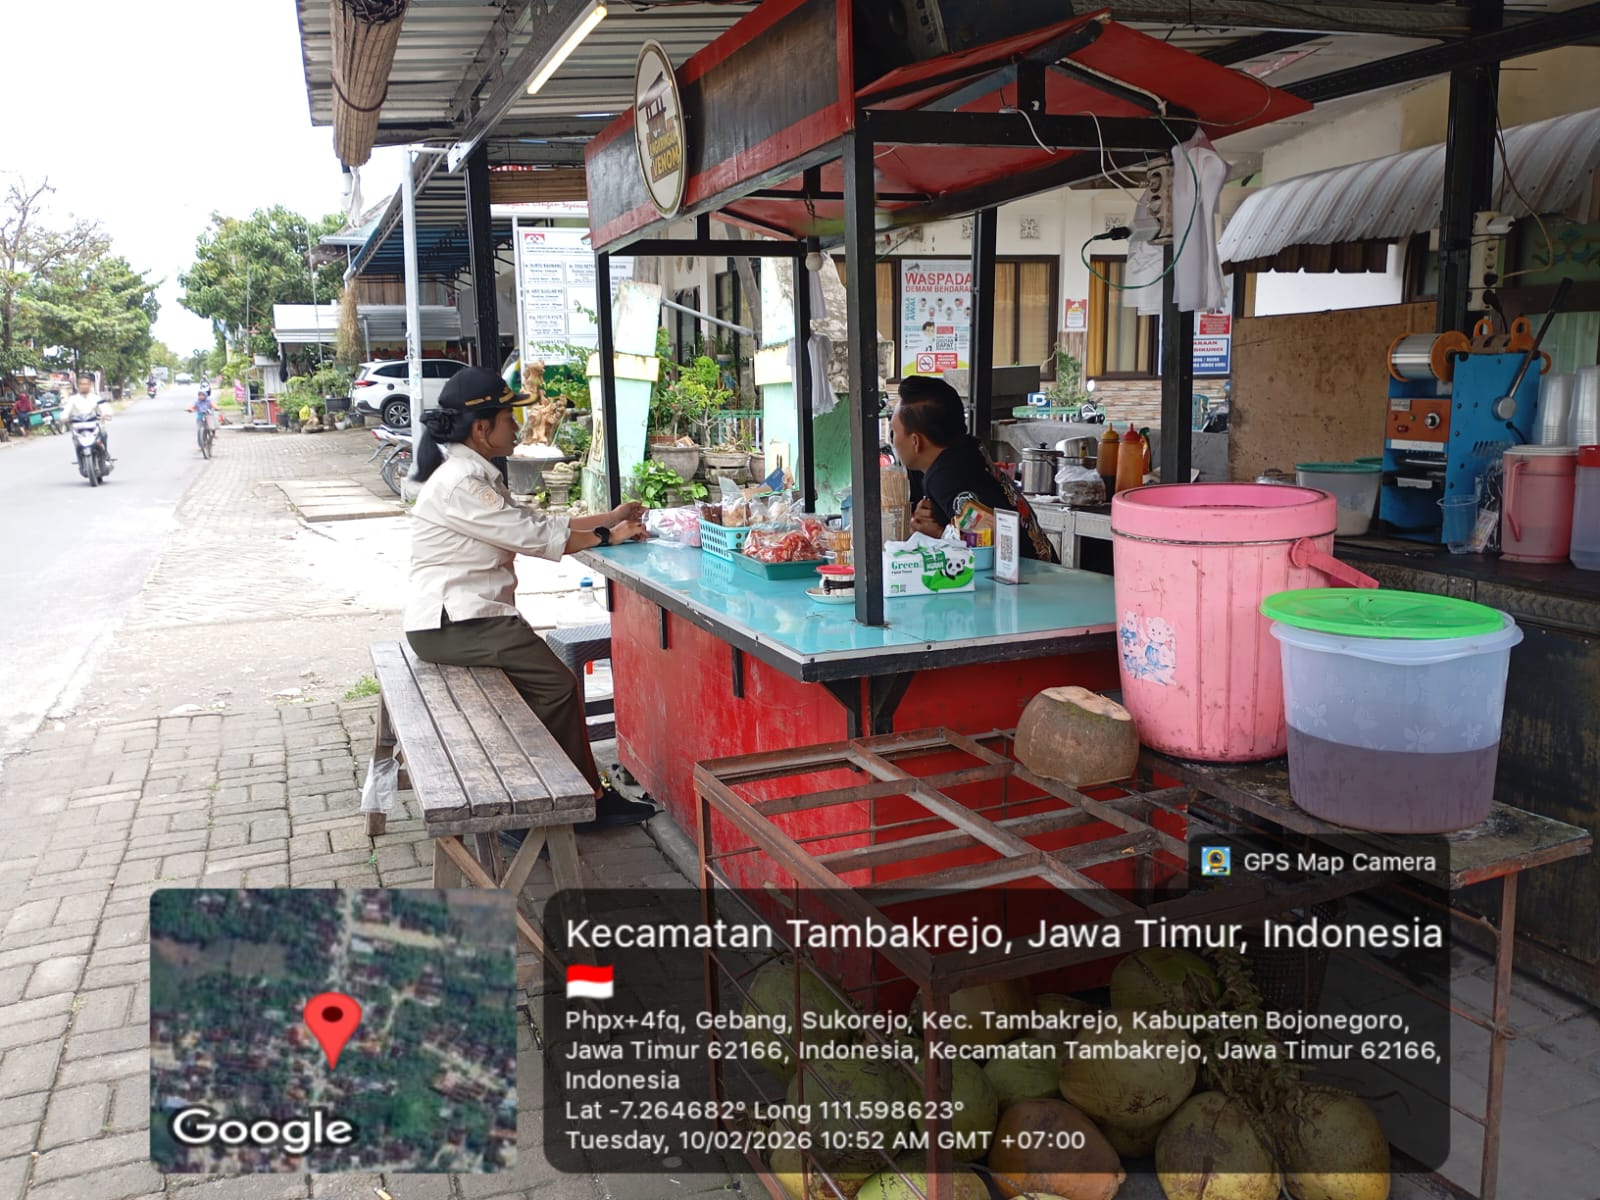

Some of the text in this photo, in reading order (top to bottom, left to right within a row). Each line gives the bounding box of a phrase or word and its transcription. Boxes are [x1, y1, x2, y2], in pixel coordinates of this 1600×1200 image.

[652, 145, 681, 177] VENOM
[904, 272, 973, 285] WASPADA
[905, 285, 933, 293] DEMAM
[891, 561, 920, 570] Green
